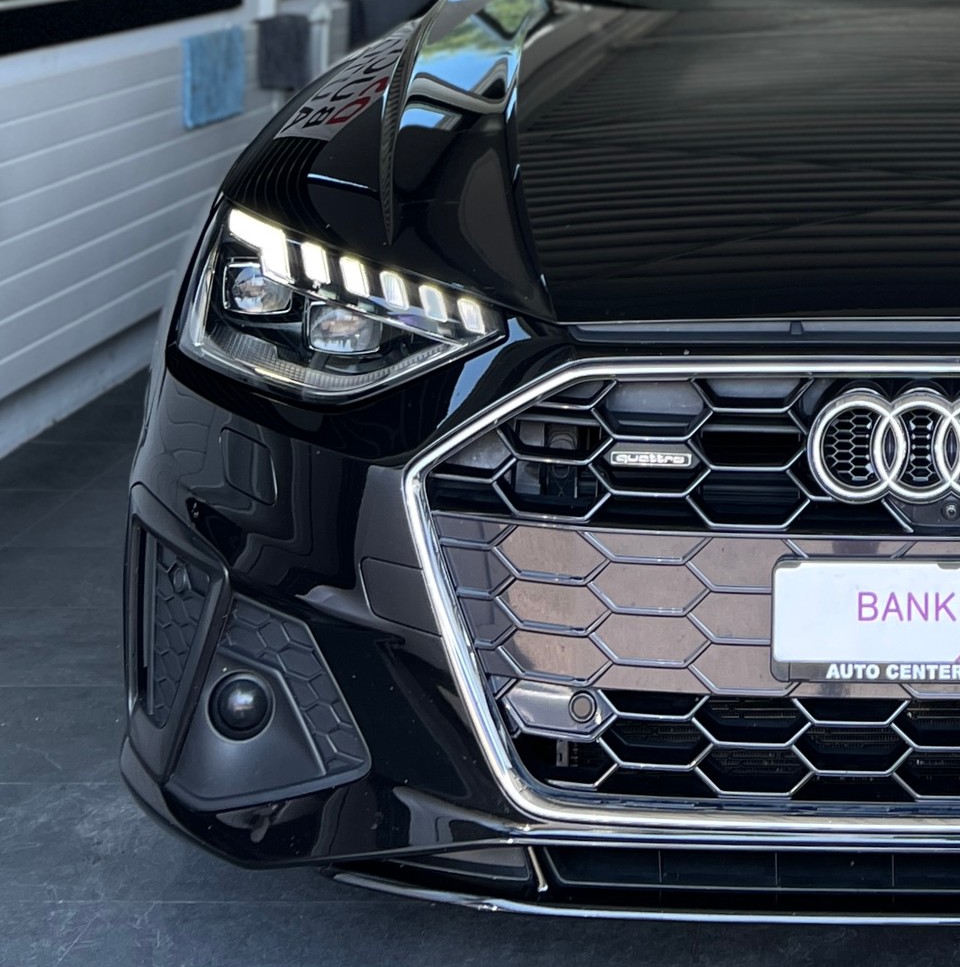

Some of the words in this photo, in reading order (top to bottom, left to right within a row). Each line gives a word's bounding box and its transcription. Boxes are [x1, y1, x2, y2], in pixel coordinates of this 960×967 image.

[615, 453, 685, 464] quattro
[857, 591, 957, 622] BANK
[825, 663, 880, 681] AUTO
